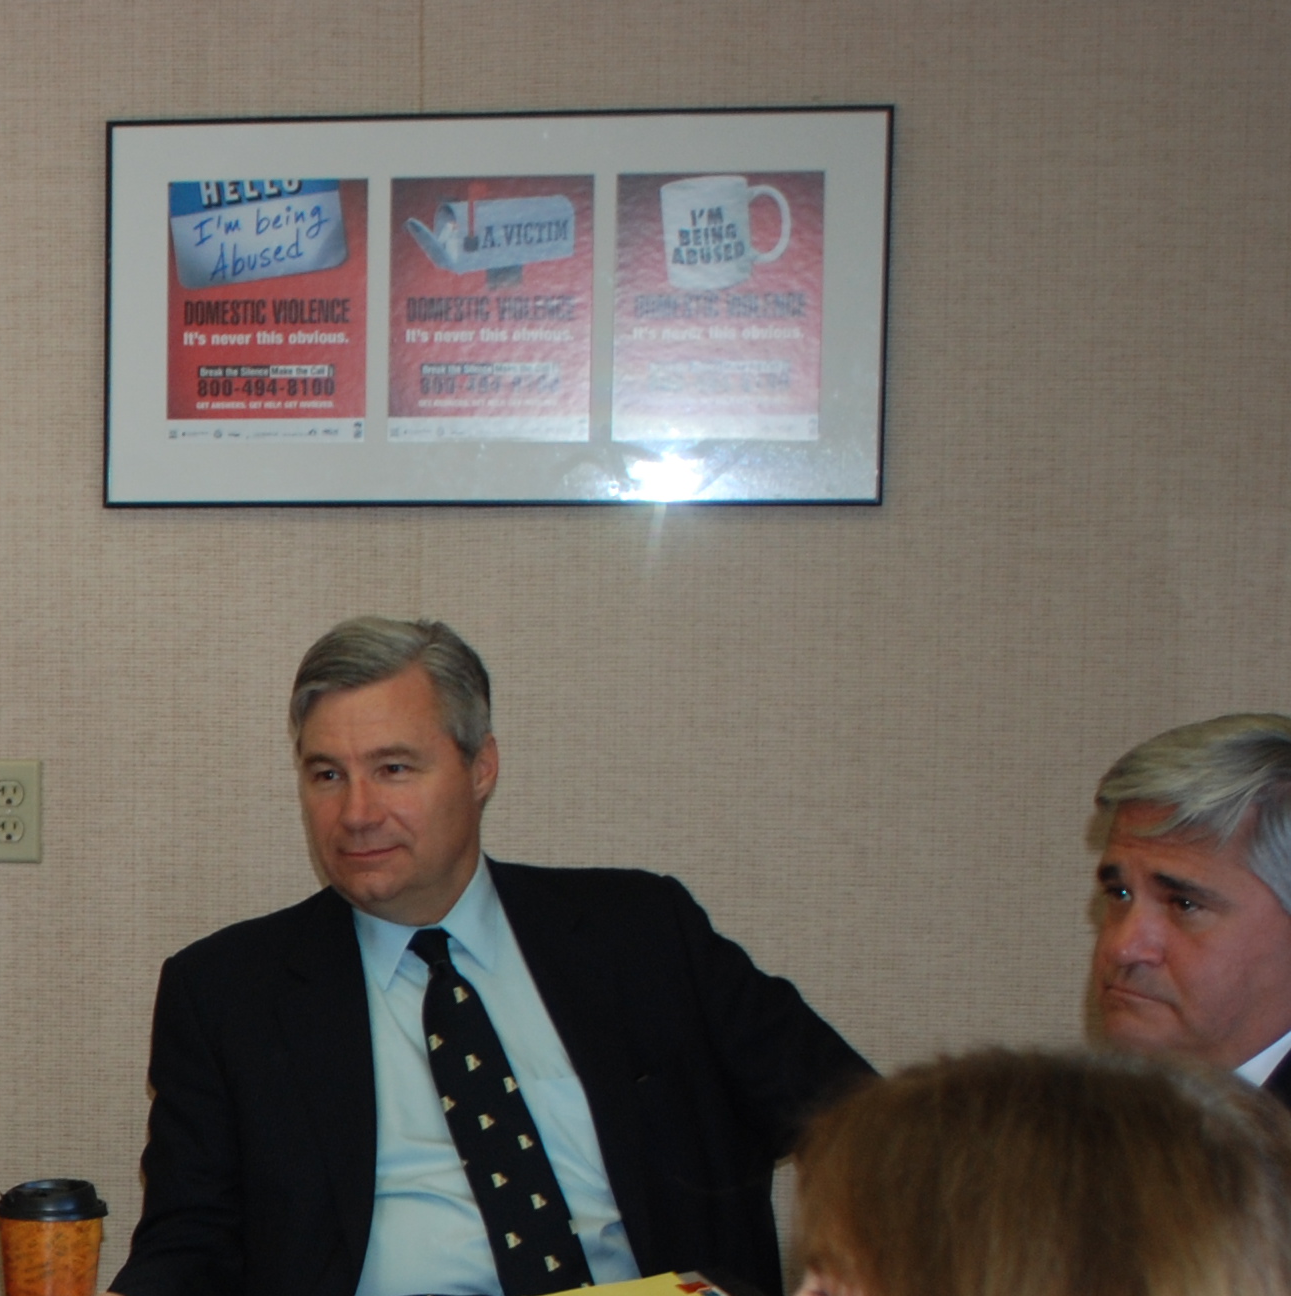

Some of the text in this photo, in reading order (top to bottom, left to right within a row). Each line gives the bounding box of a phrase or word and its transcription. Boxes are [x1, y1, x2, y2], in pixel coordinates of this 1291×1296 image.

[193, 205, 331, 246] I'm being
[690, 207, 724, 227] I'M
[678, 223, 737, 247] BEING
[210, 228, 303, 281] Abused
[672, 241, 745, 265] ABUSED
[184, 298, 351, 326] DOMESTIC VIOLENCE
[405, 295, 577, 322] DOMESTIC VIOLENCE
[183, 330, 349, 346] It's never this obvious.
[405, 328, 575, 344] It's never this obvious.
[197, 378, 335, 397] 800-494-8100
